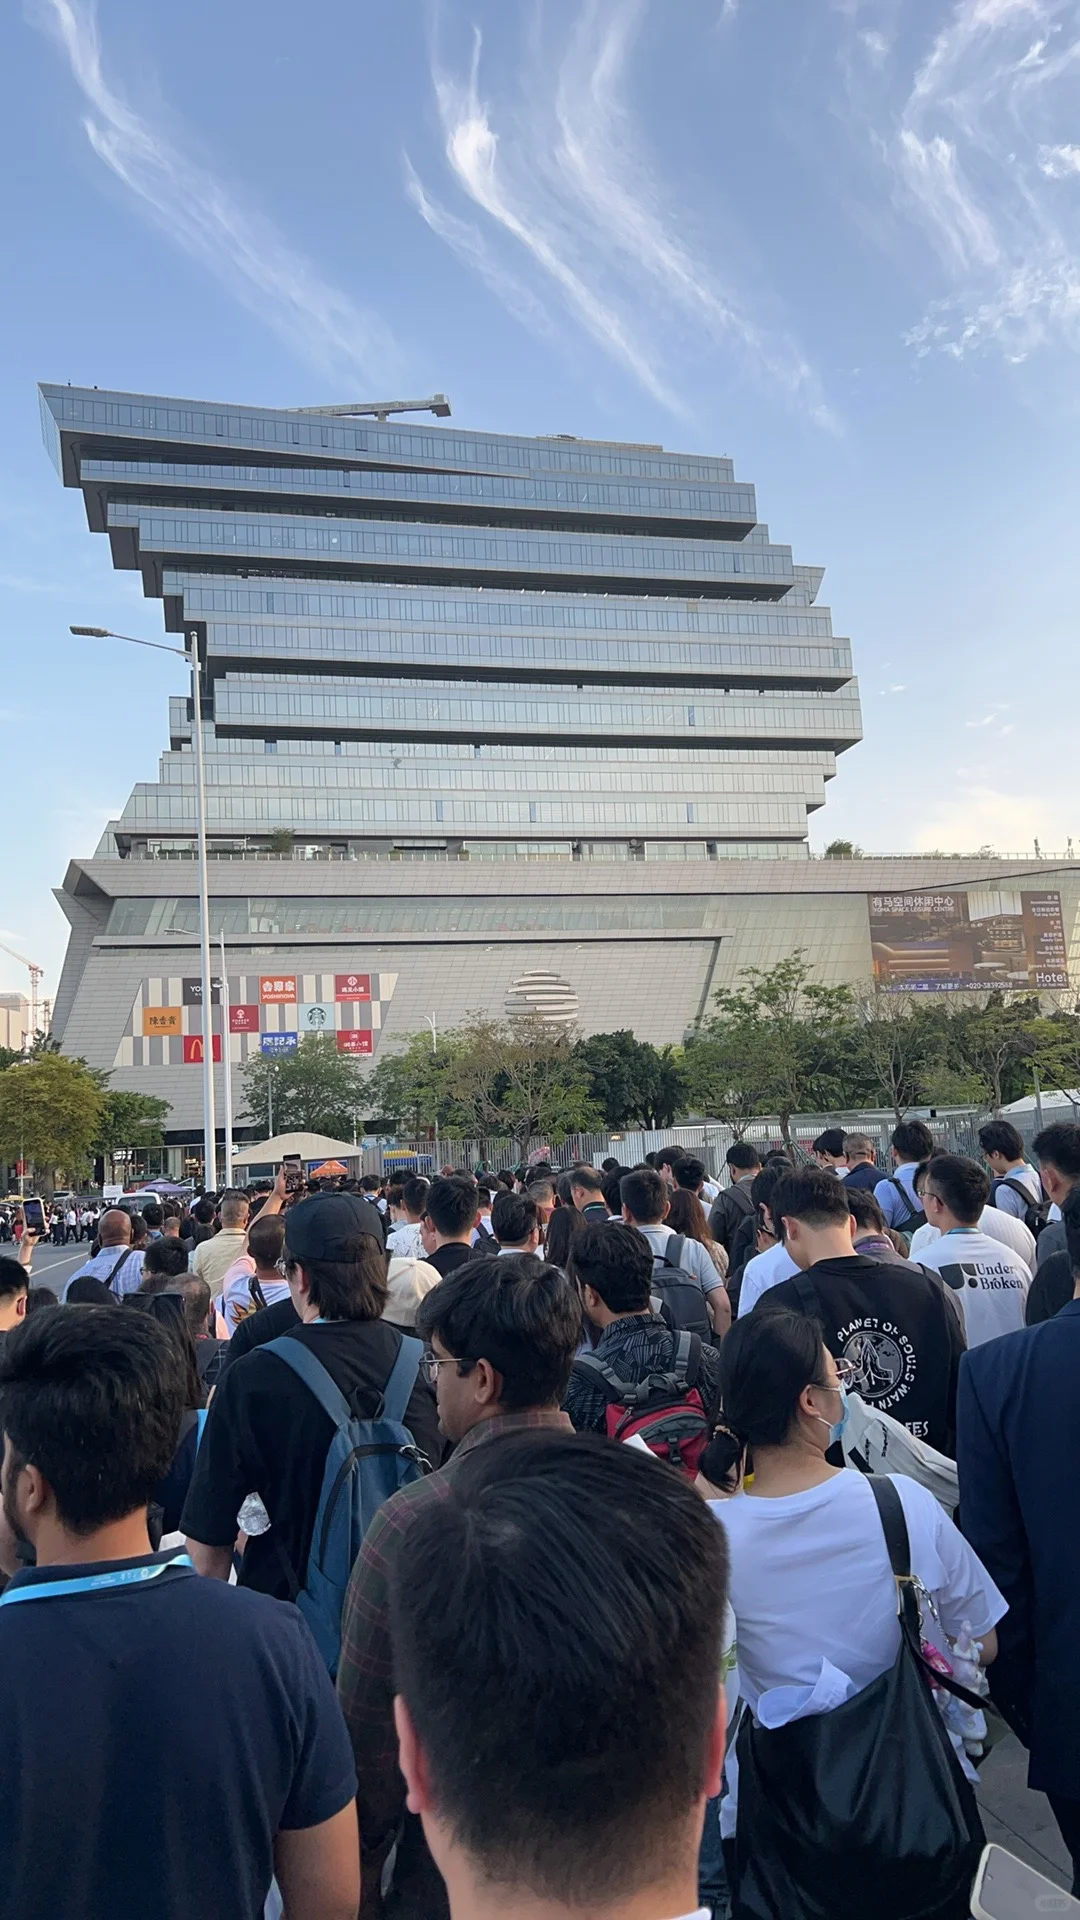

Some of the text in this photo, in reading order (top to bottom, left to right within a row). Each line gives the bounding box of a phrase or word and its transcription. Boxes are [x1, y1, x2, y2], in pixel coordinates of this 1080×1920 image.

[872, 896, 955, 907] 有马空间休闲中心
[1035, 972, 1067, 983] Hotel
[976, 1262, 1015, 1275] Under
[980, 1277, 1024, 1290] Broken
[837, 1318, 879, 1342] PLANET
[882, 1321, 900, 1336] OF
[898, 1335, 917, 1382] SOULS
